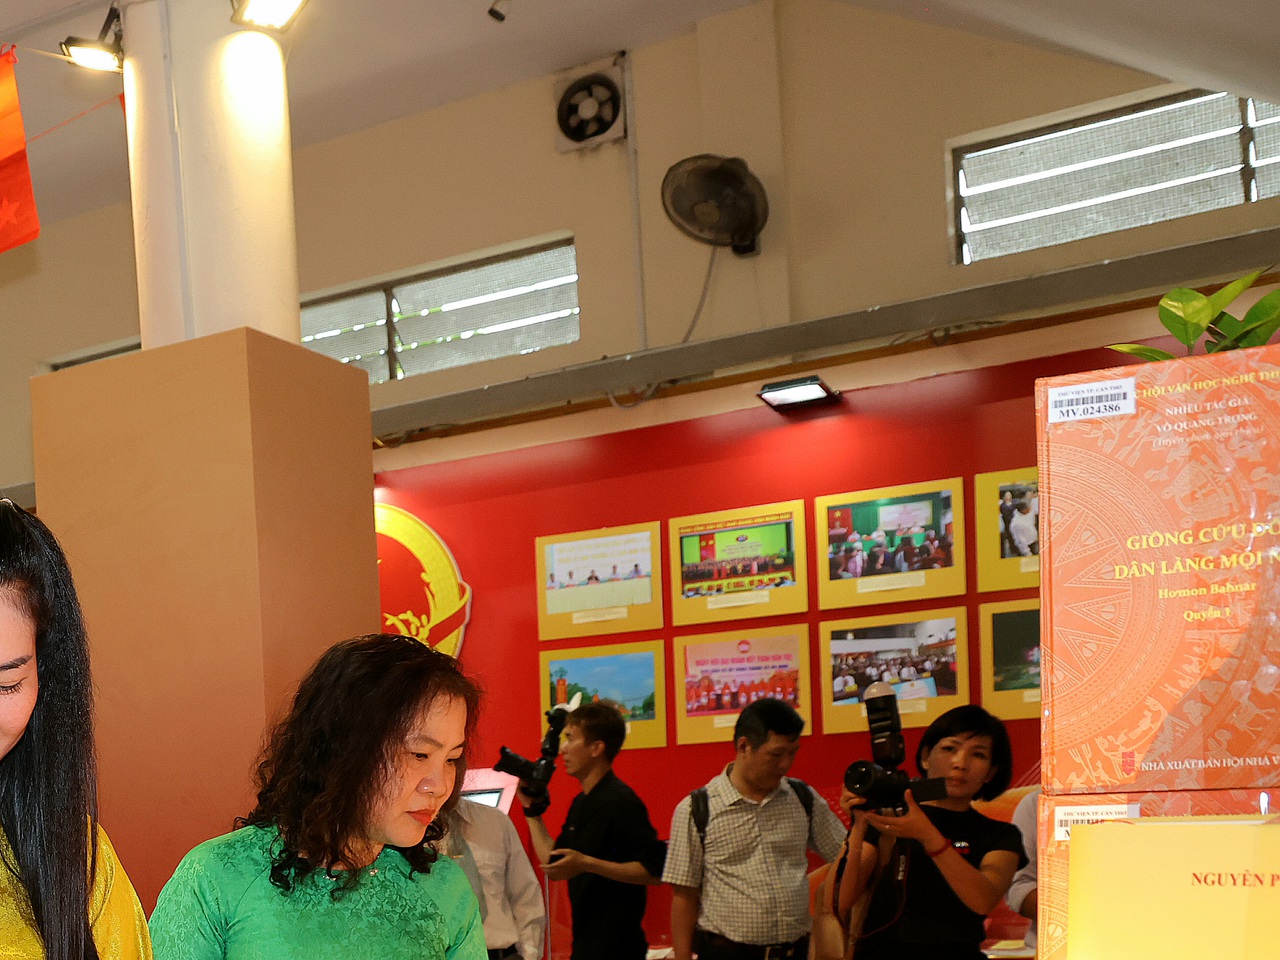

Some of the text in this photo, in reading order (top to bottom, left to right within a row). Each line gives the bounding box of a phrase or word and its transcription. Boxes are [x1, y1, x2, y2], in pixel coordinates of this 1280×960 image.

[1058, 403, 1121, 419] MV.024386
[1114, 551, 1263, 579] DÂN LÀNG MỌI
[1183, 605, 1221, 623] Quyển
